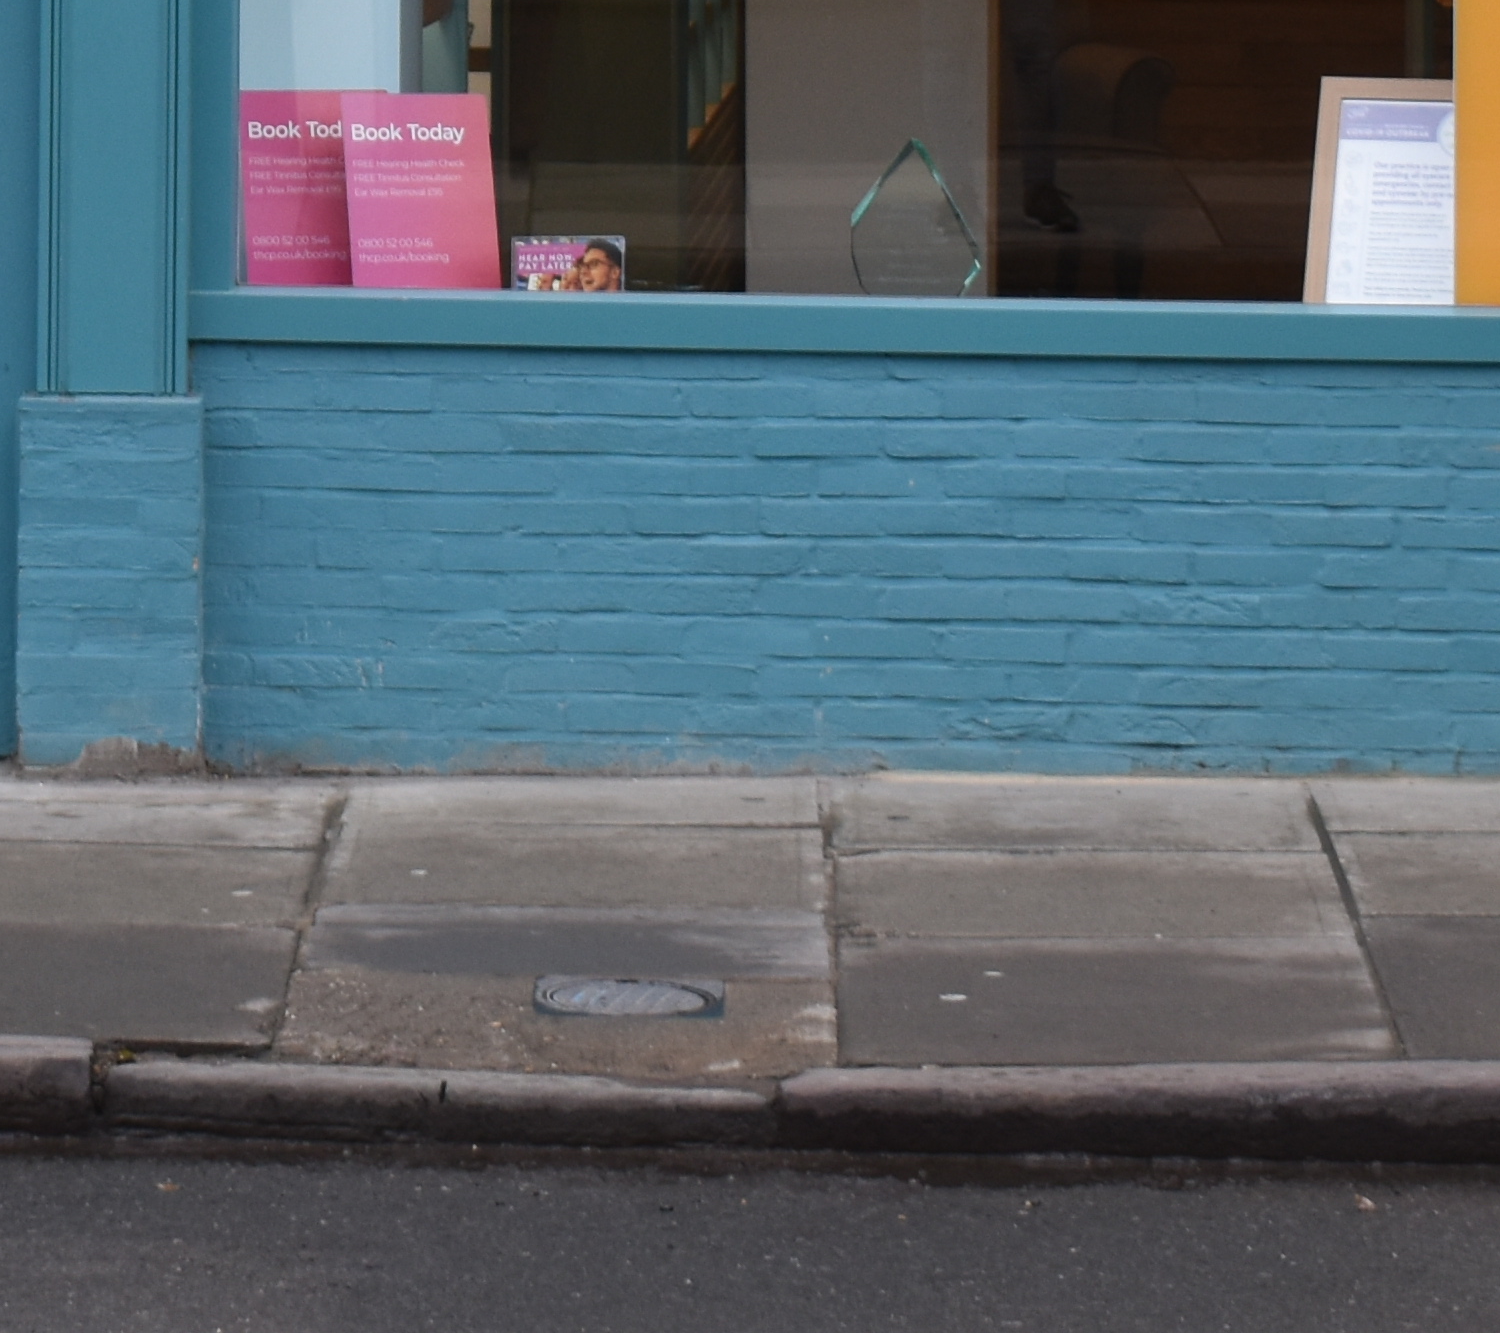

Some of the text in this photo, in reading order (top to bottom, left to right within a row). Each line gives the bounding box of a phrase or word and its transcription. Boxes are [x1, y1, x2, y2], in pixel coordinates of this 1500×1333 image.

[247, 120, 343, 139] Book Tod
[351, 122, 466, 145] Book Today
[273, 157, 307, 168] Hearing
[352, 159, 373, 168] FREE
[376, 159, 409, 170] Hearing
[410, 159, 437, 168] Health
[438, 159, 465, 168] Check
[353, 173, 375, 182] FREE
[358, 238, 384, 248] 0800
[386, 238, 398, 248] 52
[518, 253, 545, 262] HEAR
[518, 262, 537, 270] PAY
